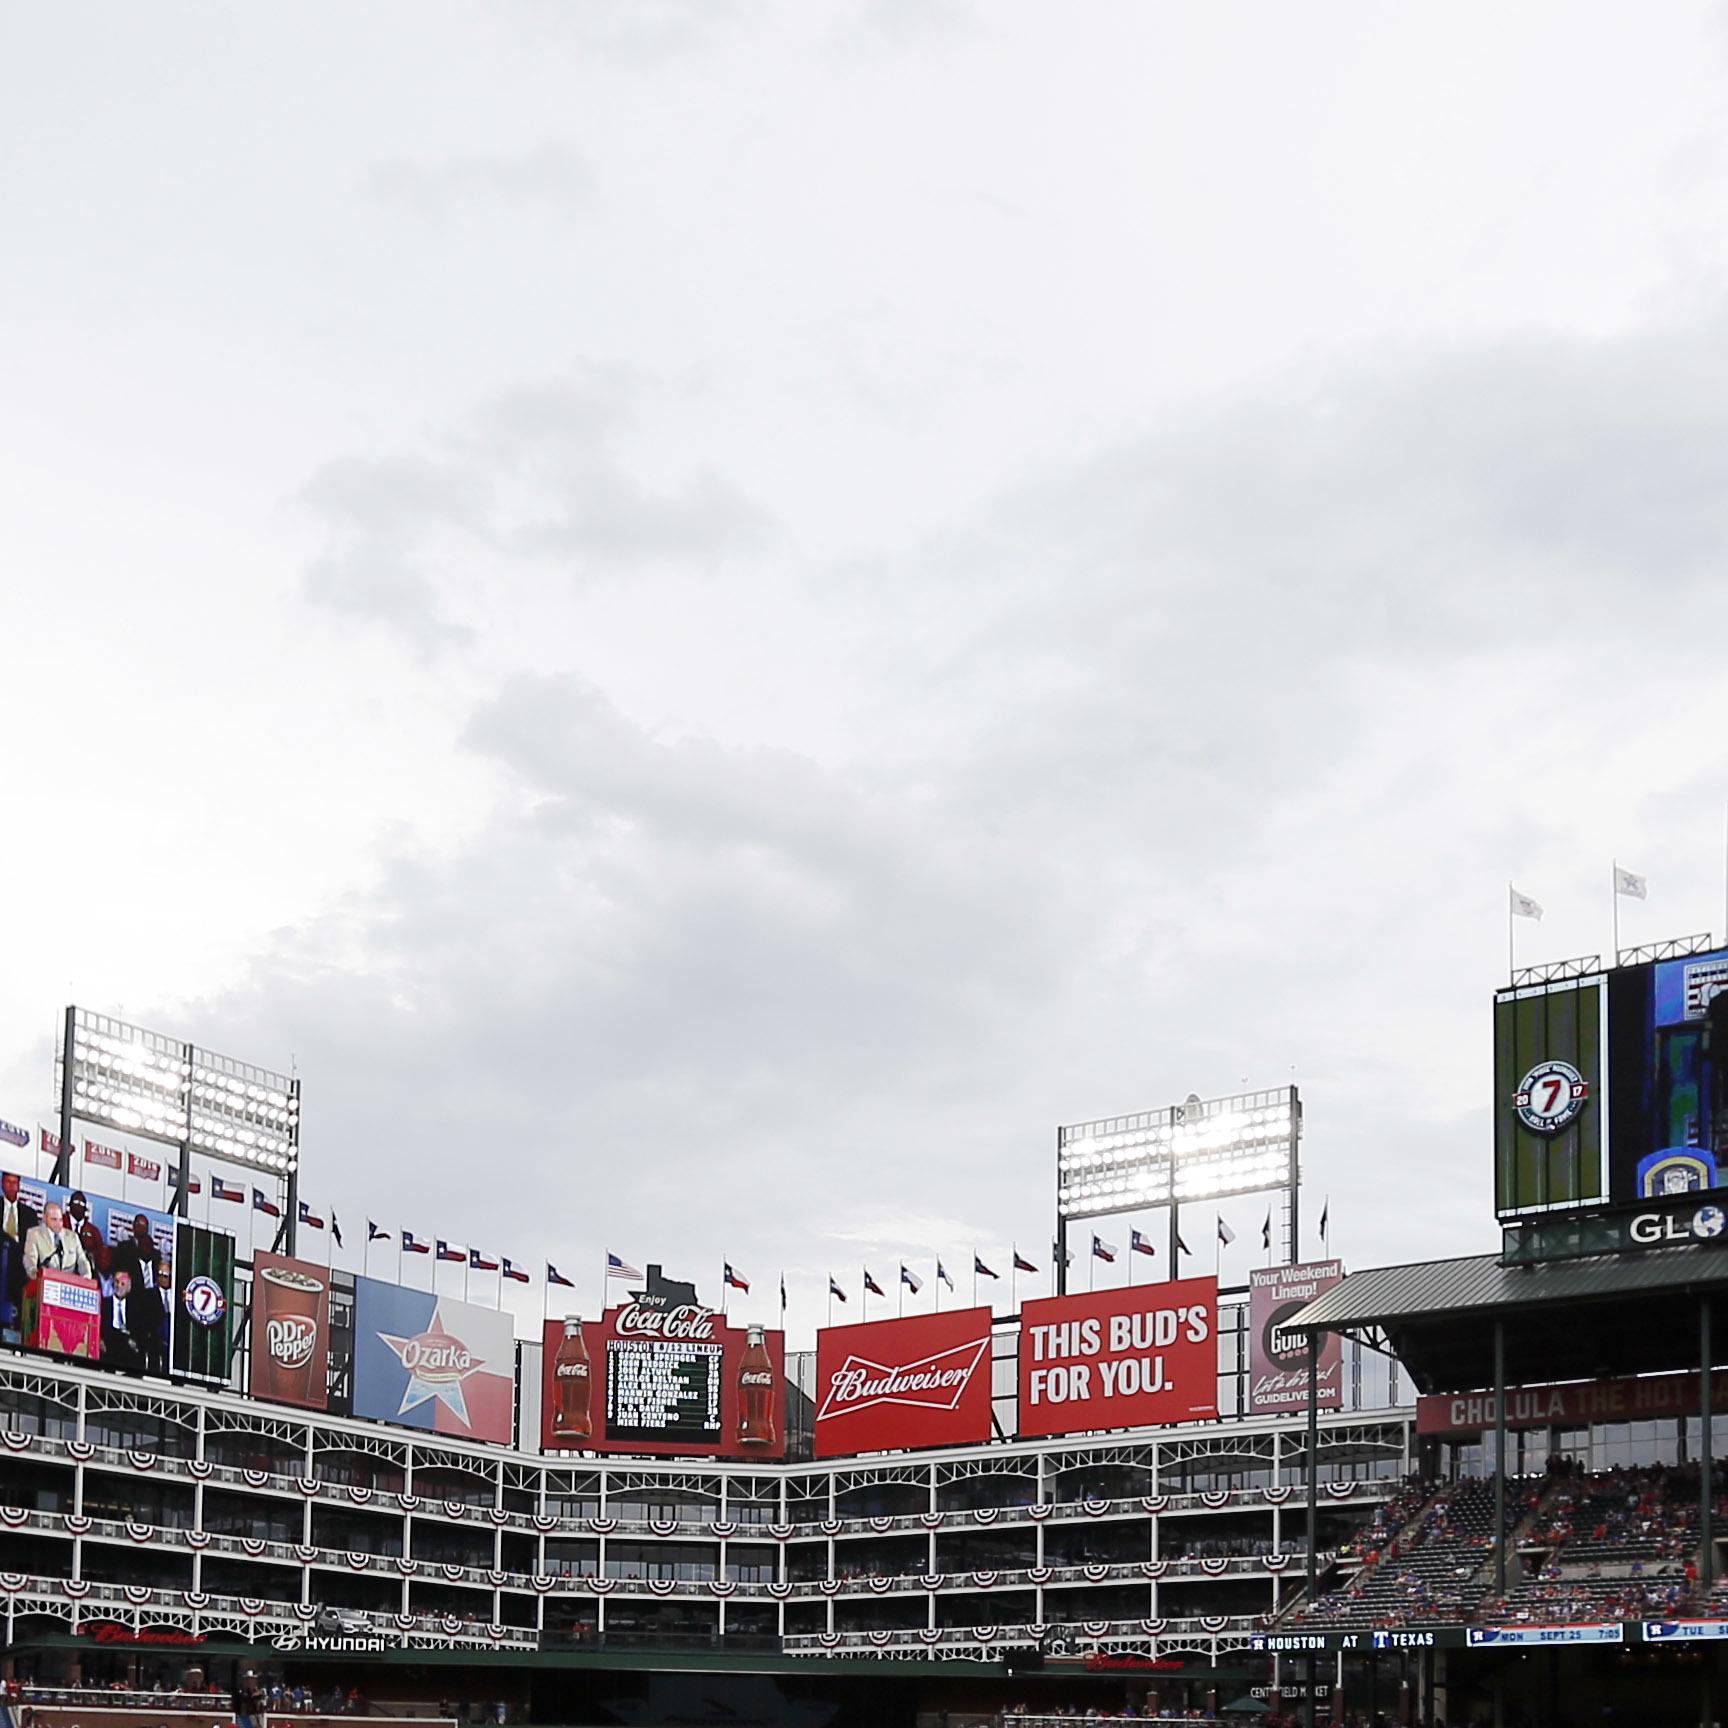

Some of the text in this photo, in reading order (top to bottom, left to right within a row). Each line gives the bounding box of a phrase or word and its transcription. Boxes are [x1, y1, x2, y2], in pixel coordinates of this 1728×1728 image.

[1543, 1080, 1561, 1112] 7
[1252, 1263, 1339, 1287] Your Weekend
[200, 1290, 212, 1311] 7
[638, 1295, 666, 1306] Enjoy
[1272, 1282, 1317, 1300] Lineup!
[282, 1320, 307, 1342] Dr
[616, 1303, 715, 1339] Coca-Cola
[269, 1321, 315, 1362] Pepper
[1030, 1305, 1209, 1361] THIS BUD'S
[401, 1341, 471, 1369] Ozarka
[608, 1342, 722, 1354] HOUSTON 8/12 LINEUP
[832, 1366, 970, 1402] Budweiser
[1030, 1357, 1173, 1404] FOR YOU.
[1450, 1394, 1565, 1426] CHOLULA
[1577, 1387, 1625, 1414] THE
[1635, 1382, 1684, 1408] HOT
[1267, 1633, 1434, 1650] HOUSTON AT TEXAS
[1501, 1629, 1620, 1643] MON SEPT 25 7:05
[1682, 1626, 1705, 1636] TUE
[305, 1636, 385, 1651] HYUNDAI
